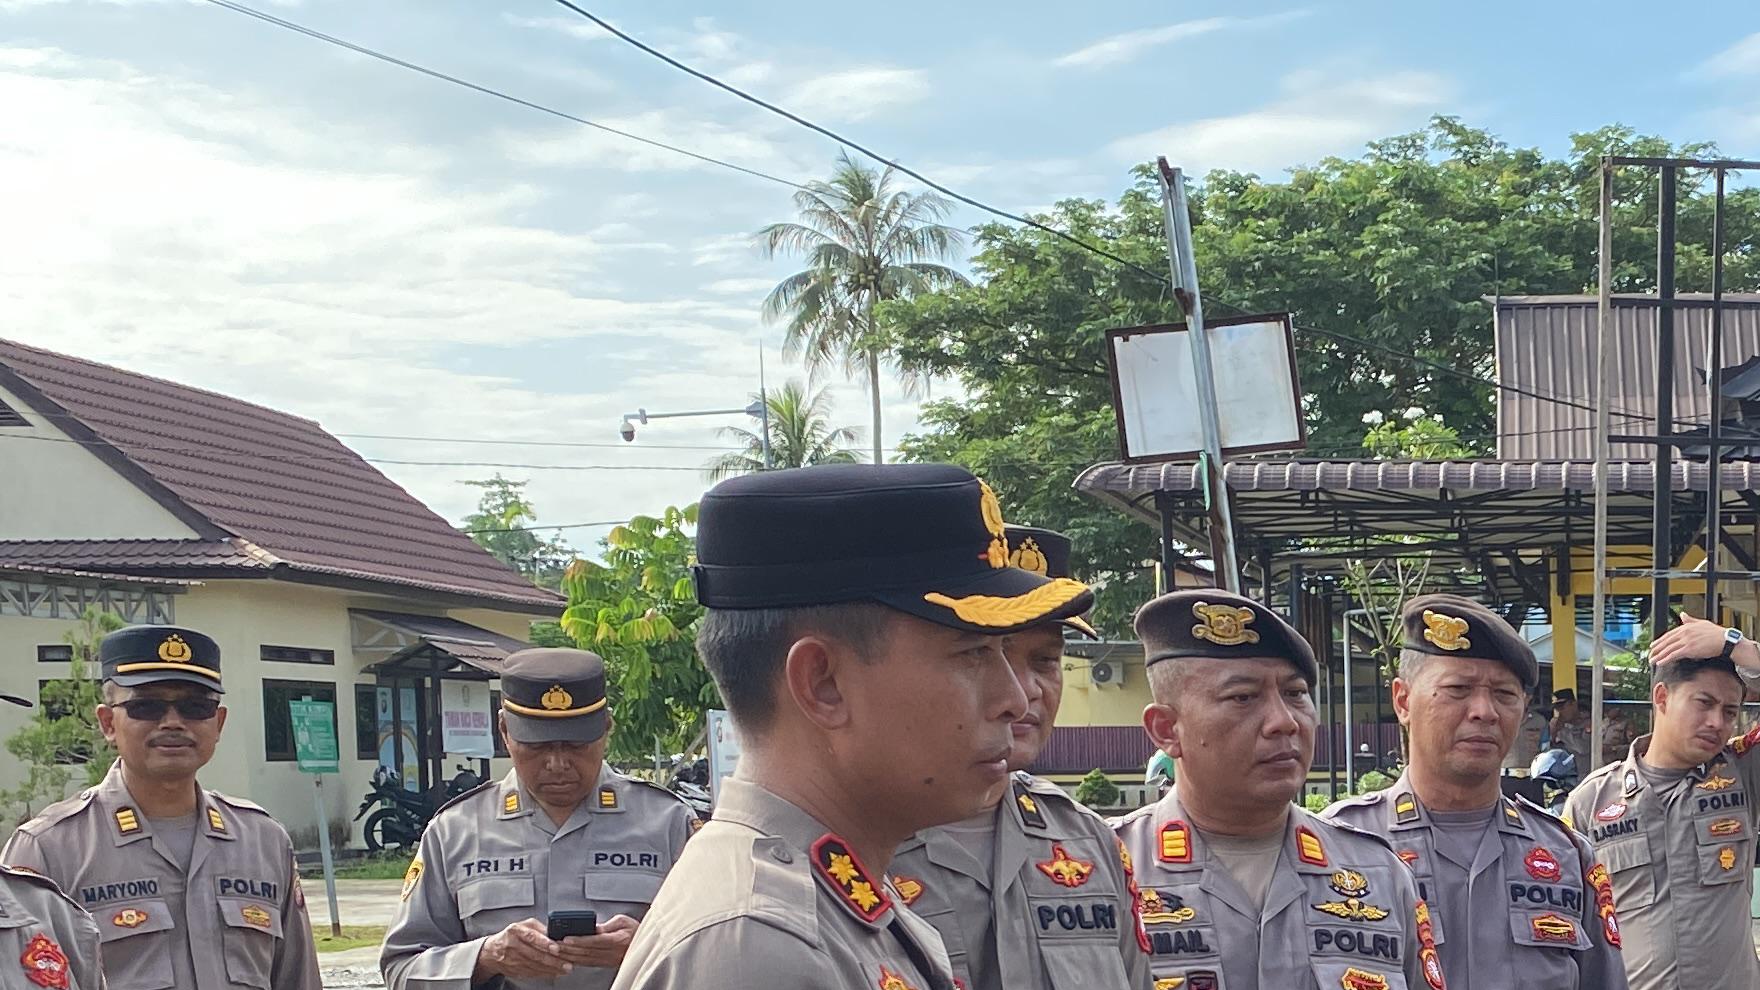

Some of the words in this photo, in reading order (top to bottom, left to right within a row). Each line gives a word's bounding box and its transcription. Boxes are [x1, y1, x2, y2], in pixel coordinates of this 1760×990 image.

[1700, 792, 1745, 812] POLRI
[463, 860, 499, 876] TRI
[509, 858, 524, 871] H
[594, 853, 658, 868] POLRI
[82, 879, 158, 903] MARYONO
[220, 878, 277, 900] POLRI
[1510, 883, 1582, 913] POLRI
[1037, 903, 1116, 931] POLRI
[1314, 928, 1398, 959] POLRI
